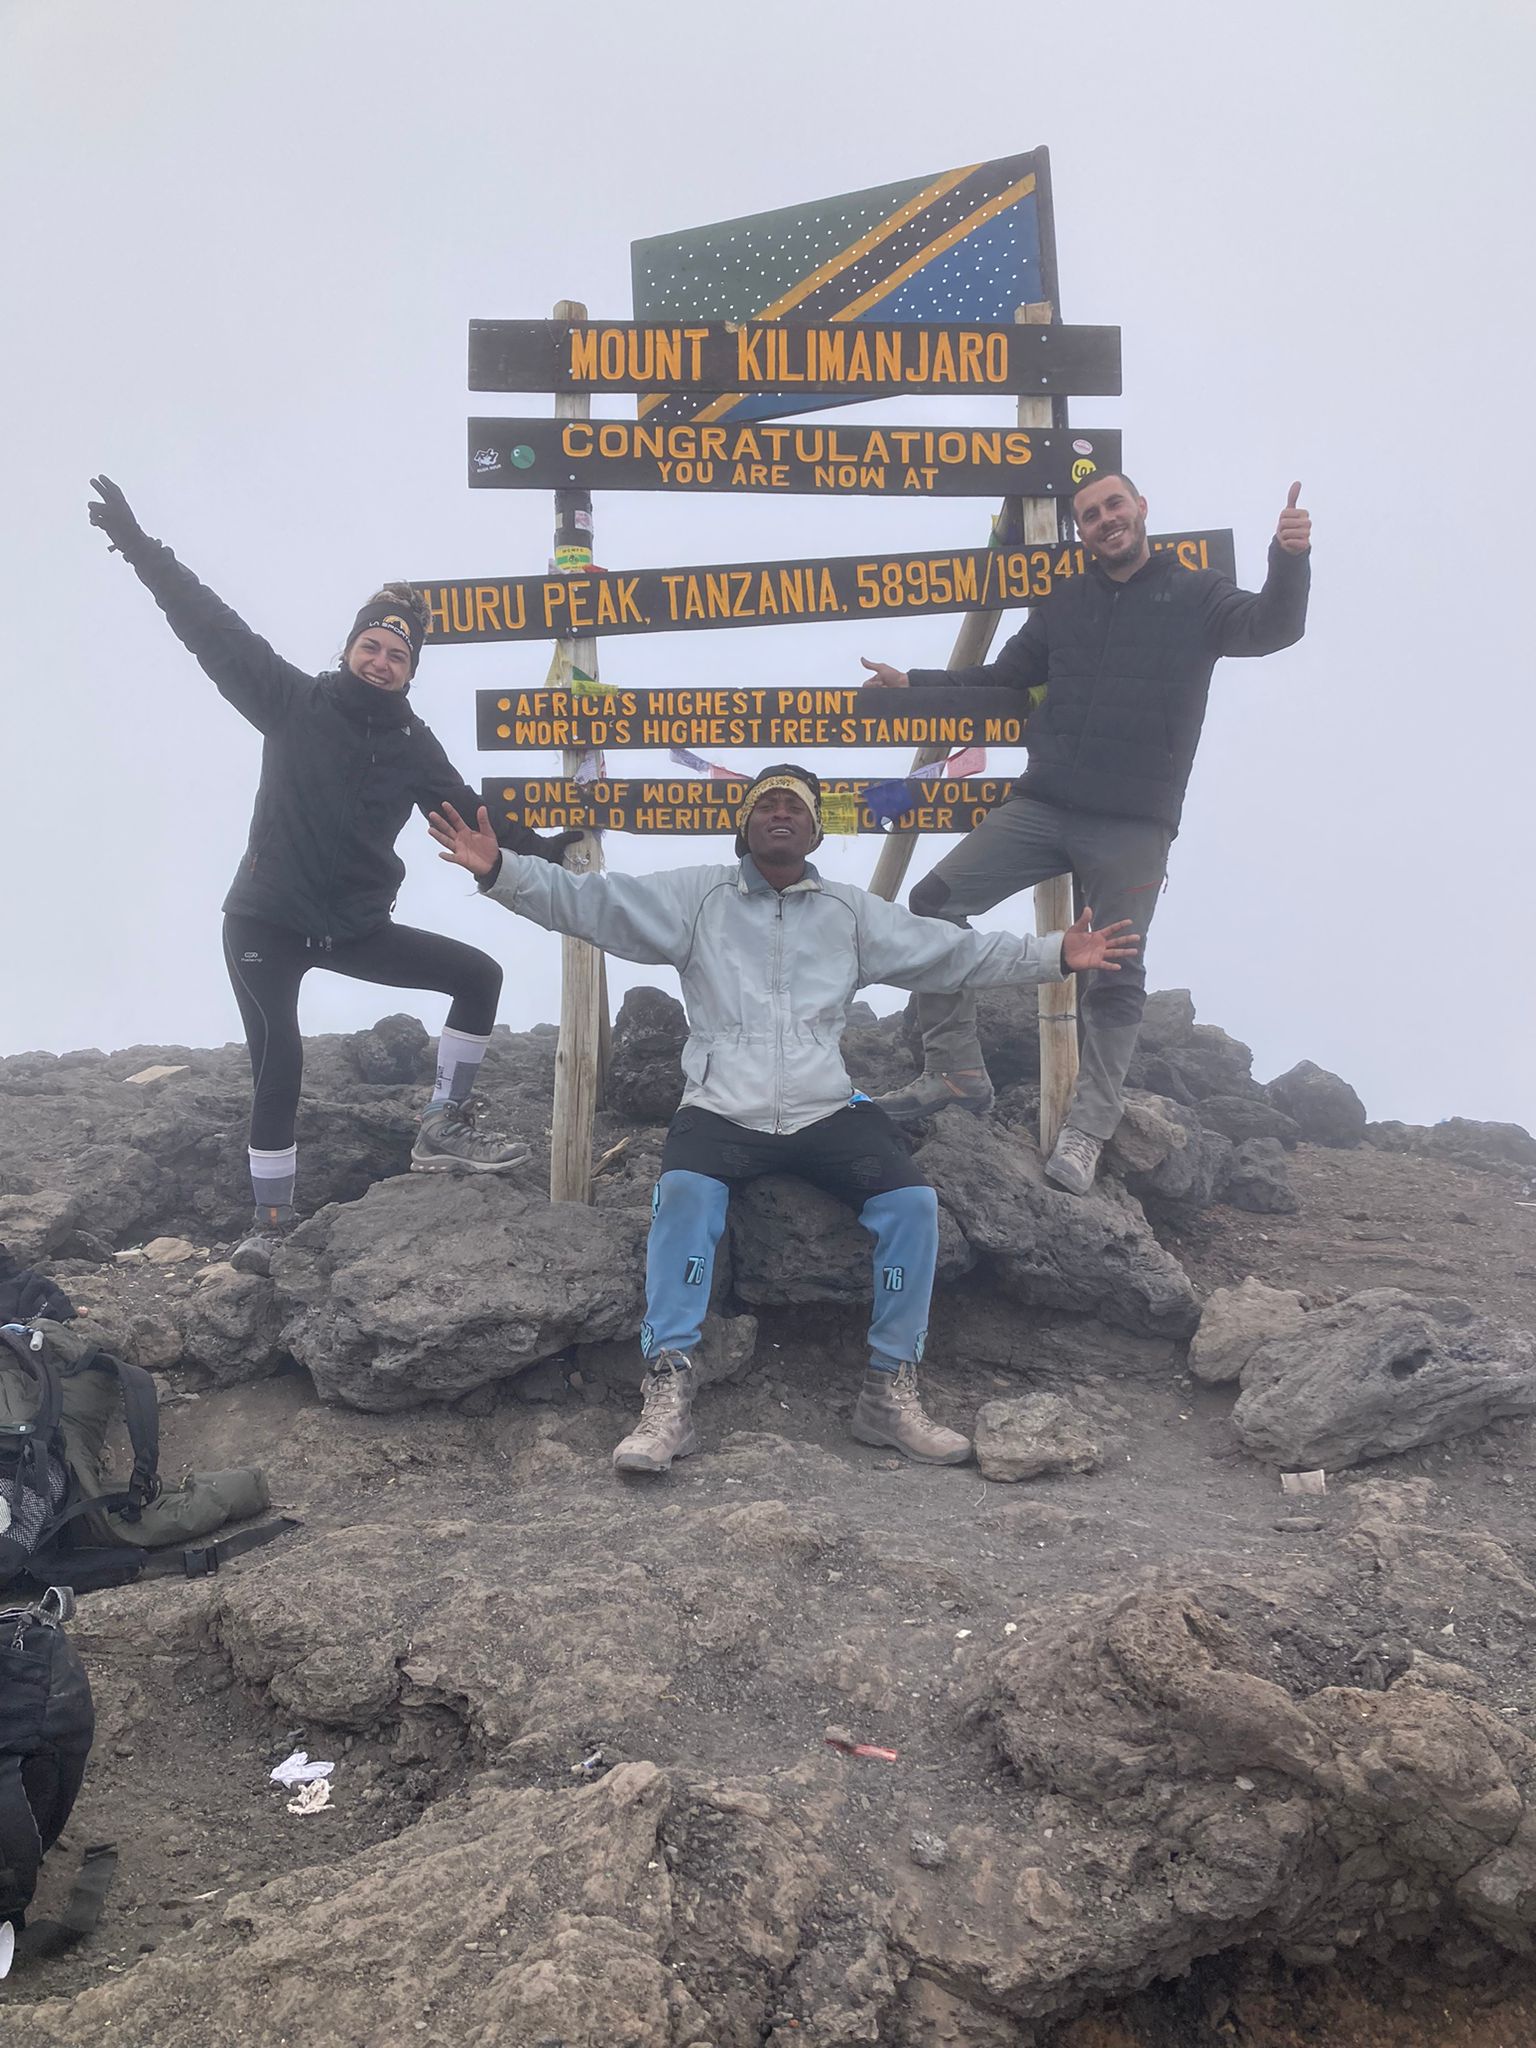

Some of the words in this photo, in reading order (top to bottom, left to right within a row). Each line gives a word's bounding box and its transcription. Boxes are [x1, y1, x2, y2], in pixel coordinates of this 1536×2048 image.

[571, 328, 709, 381] MOUNT
[737, 328, 1008, 383] KILIMANJARO
[562, 423, 1032, 465] CONGRATULATIONS
[656, 461, 714, 484] YOU
[731, 463, 790, 487] ARE
[814, 465, 885, 489] NOW
[904, 467, 939, 490] AT
[420, 583, 526, 634] HURU
[648, 690, 767, 717] HIGHEST
[777, 690, 858, 715] POINT
[515, 719, 632, 745] WORLD'S
[643, 718, 764, 744] HIGHEST
[524, 781, 581, 804] ONE
[593, 782, 630, 804] OF
[685, 1256, 705, 1285] 76
[882, 1266, 904, 1291] 76
